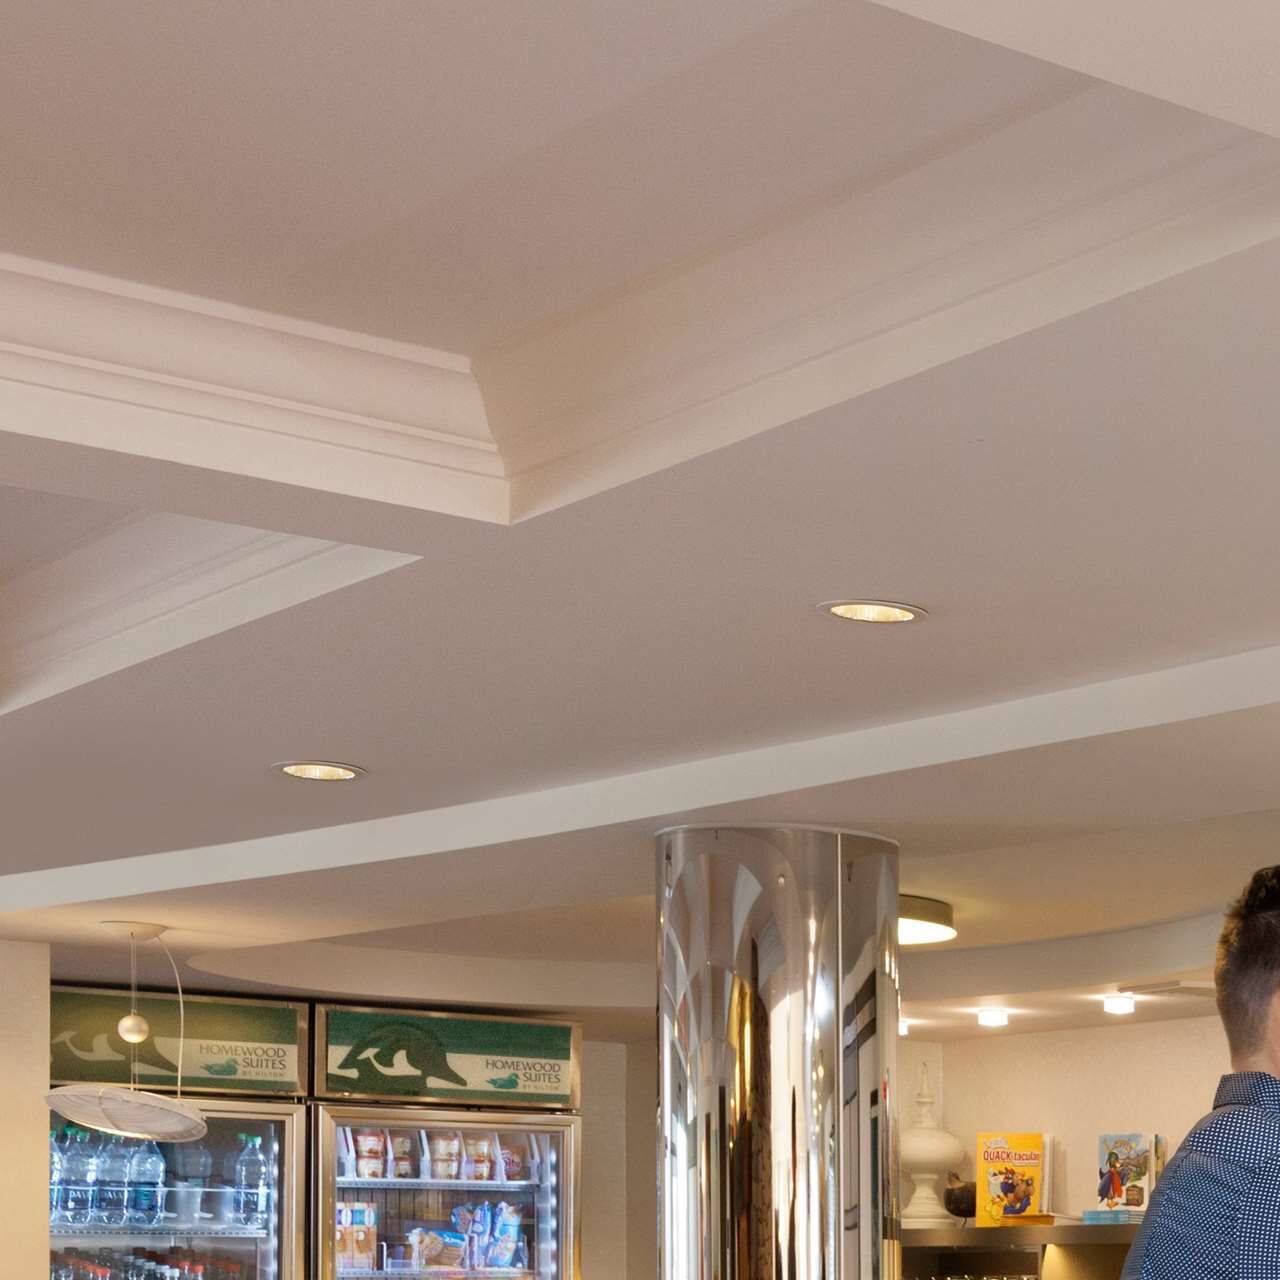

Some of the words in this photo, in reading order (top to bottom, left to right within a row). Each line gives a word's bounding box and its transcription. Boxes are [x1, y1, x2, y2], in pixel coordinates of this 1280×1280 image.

[200, 1044, 286, 1058] HOMEWOOD
[243, 1058, 286, 1070] SUITES
[486, 1059, 561, 1073] HOMEWOOD
[523, 1072, 561, 1084] SUITES
